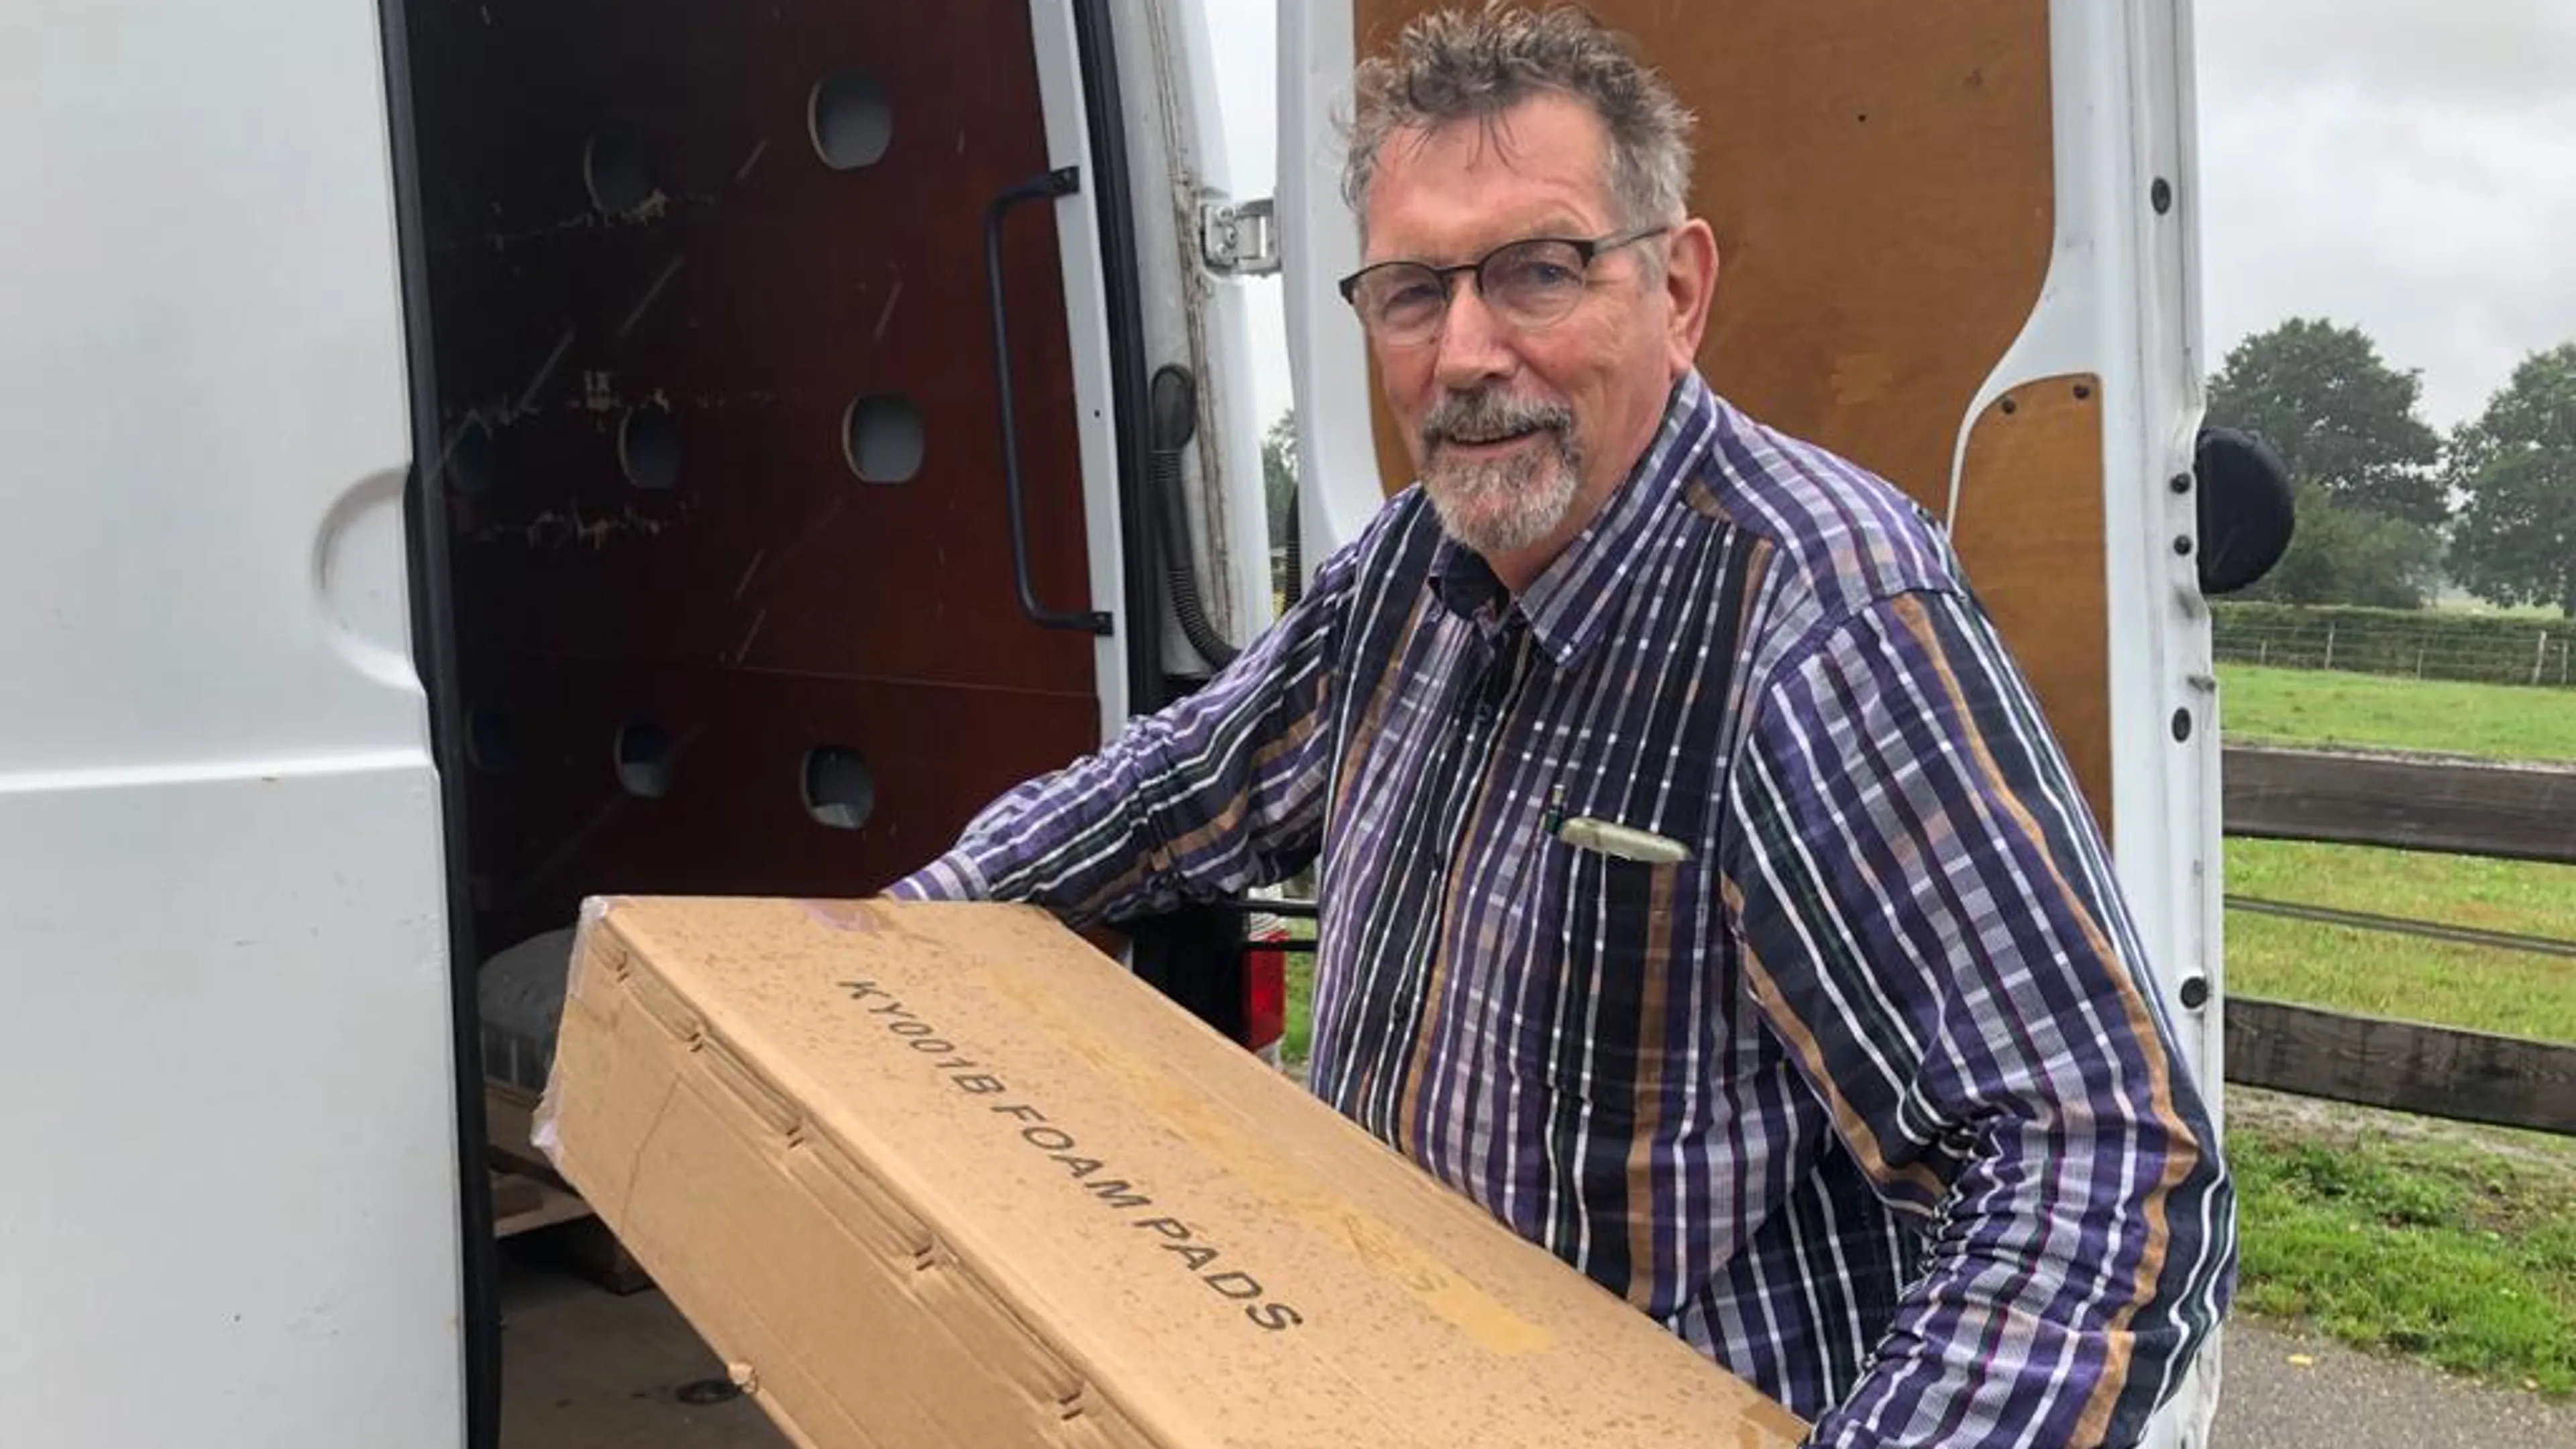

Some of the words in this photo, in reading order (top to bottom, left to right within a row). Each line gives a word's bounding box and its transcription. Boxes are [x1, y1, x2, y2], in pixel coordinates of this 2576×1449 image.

[837, 979, 1006, 1095] KY001B
[991, 1104, 1152, 1209] FOAM
[1133, 1216, 1304, 1333] PADS
